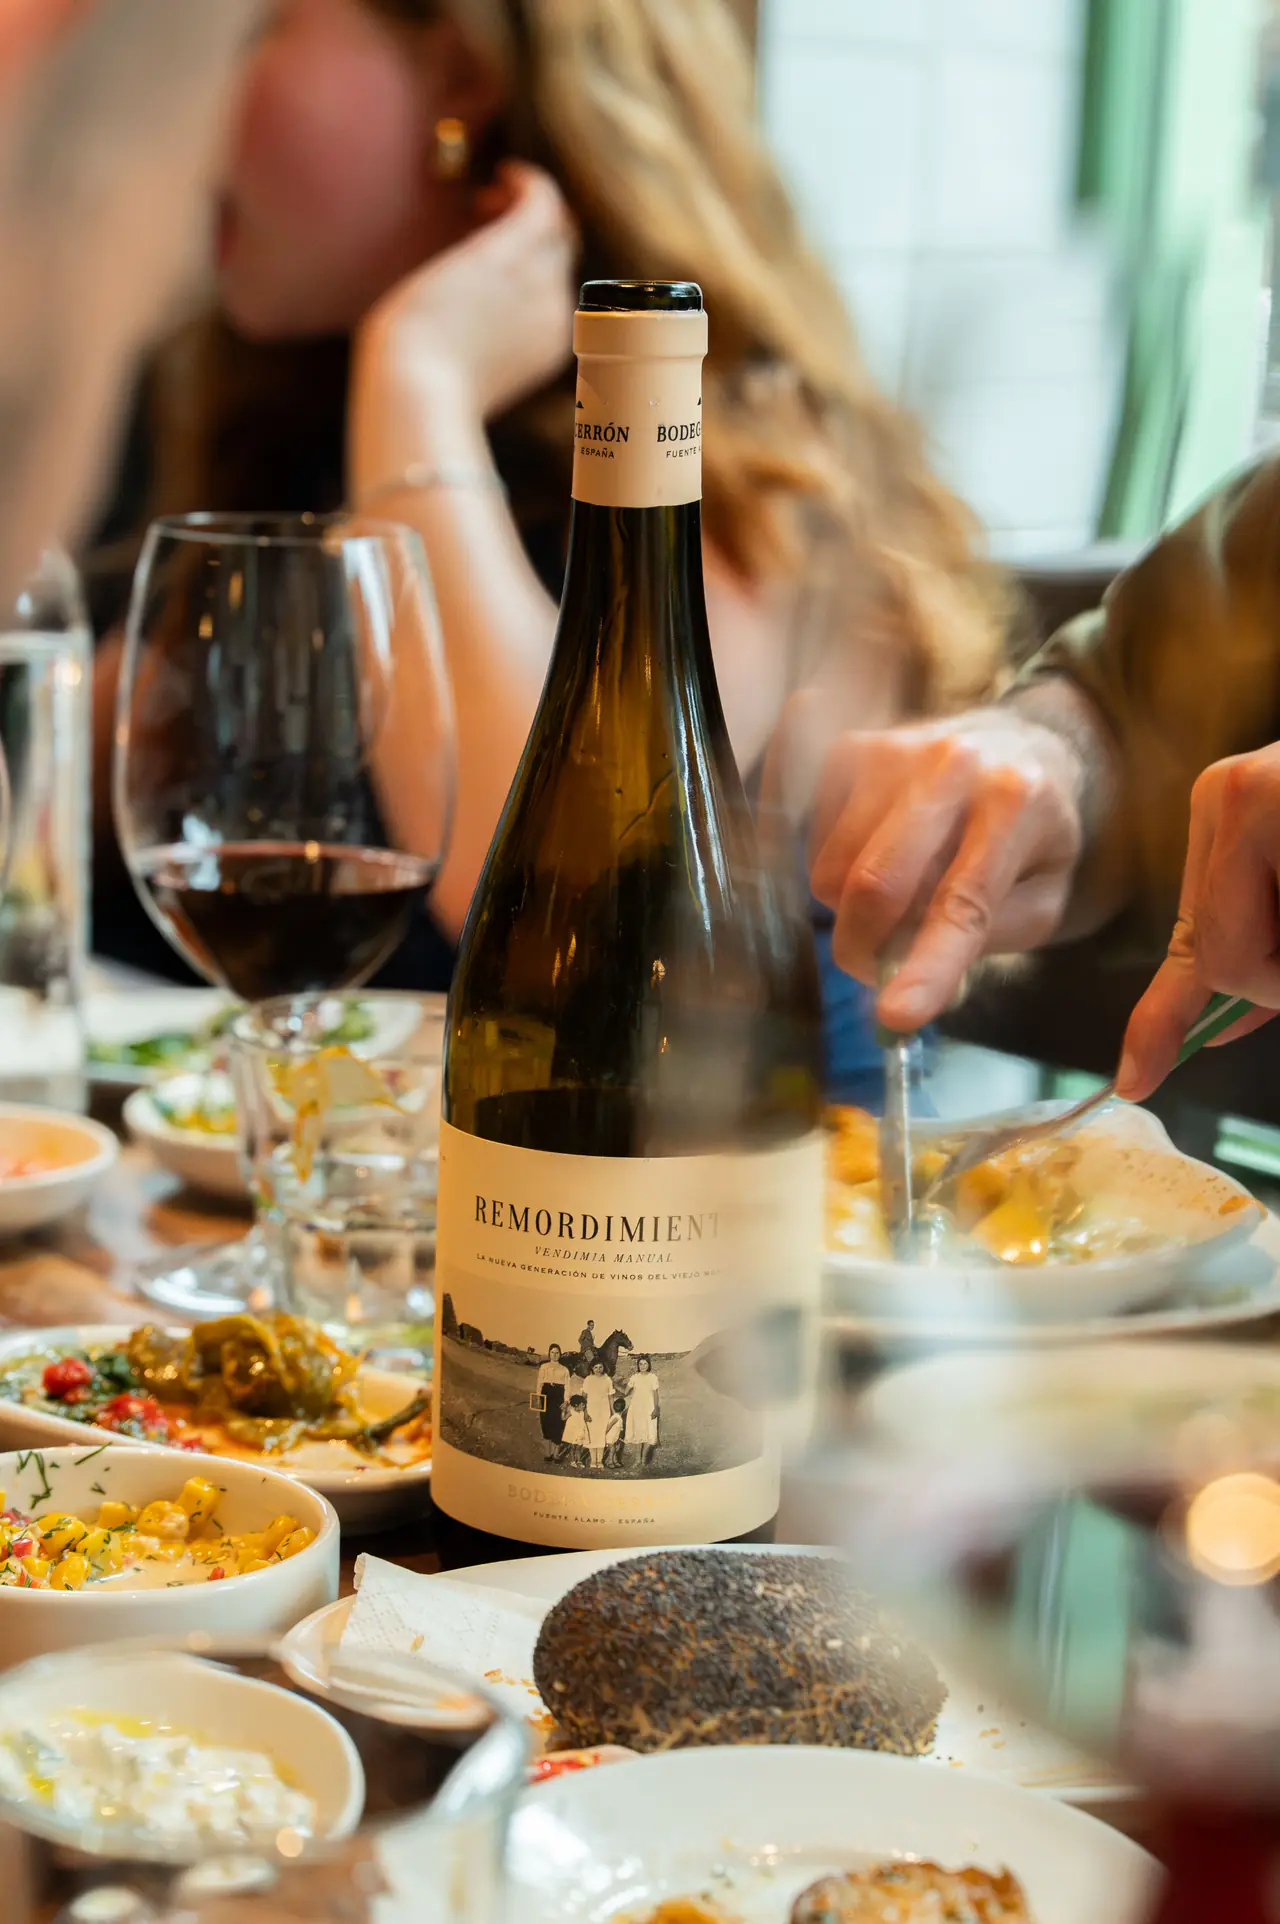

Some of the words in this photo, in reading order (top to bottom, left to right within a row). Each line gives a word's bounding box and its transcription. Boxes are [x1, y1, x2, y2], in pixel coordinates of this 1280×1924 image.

[581, 446, 615, 459] ESPAÑA
[666, 446, 697, 458] FUENTE
[475, 1194, 720, 1243] REMORDIMIENT
[535, 1245, 606, 1263] VENDIMIA
[613, 1252, 673, 1264] MANUAL
[476, 1252, 486, 1261] LA
[489, 1257, 517, 1269] NUEVA
[520, 1263, 587, 1279] GENERACIÓN
[591, 1272, 605, 1280] DE
[610, 1272, 643, 1281] VINOS
[647, 1272, 668, 1281] DEL
[618, 1517, 656, 1525] ESPAÑA
